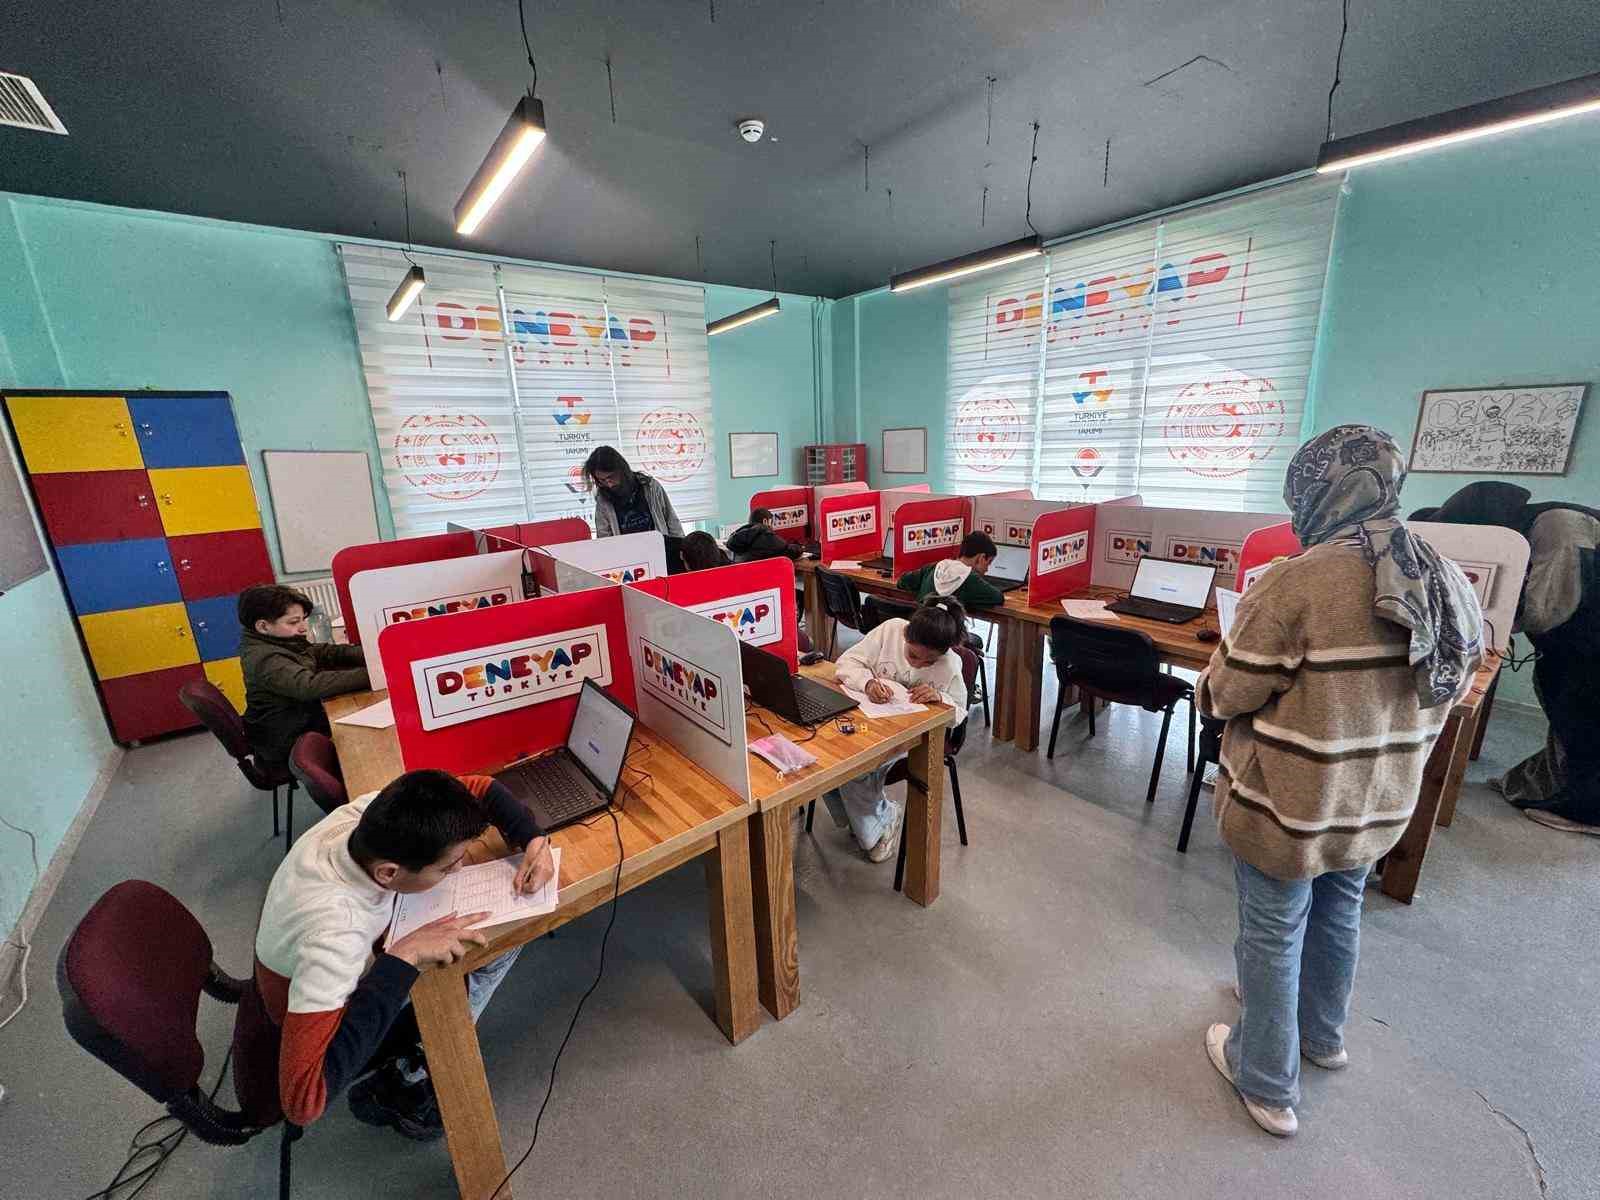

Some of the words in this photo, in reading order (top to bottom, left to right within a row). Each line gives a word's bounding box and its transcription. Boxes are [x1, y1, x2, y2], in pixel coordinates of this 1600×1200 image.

[908, 524, 960, 541] DENEYAP
[436, 642, 592, 696] DENEYAP
[467, 670, 574, 702] TÜRKİYE
[644, 645, 717, 700] DENEYAP
